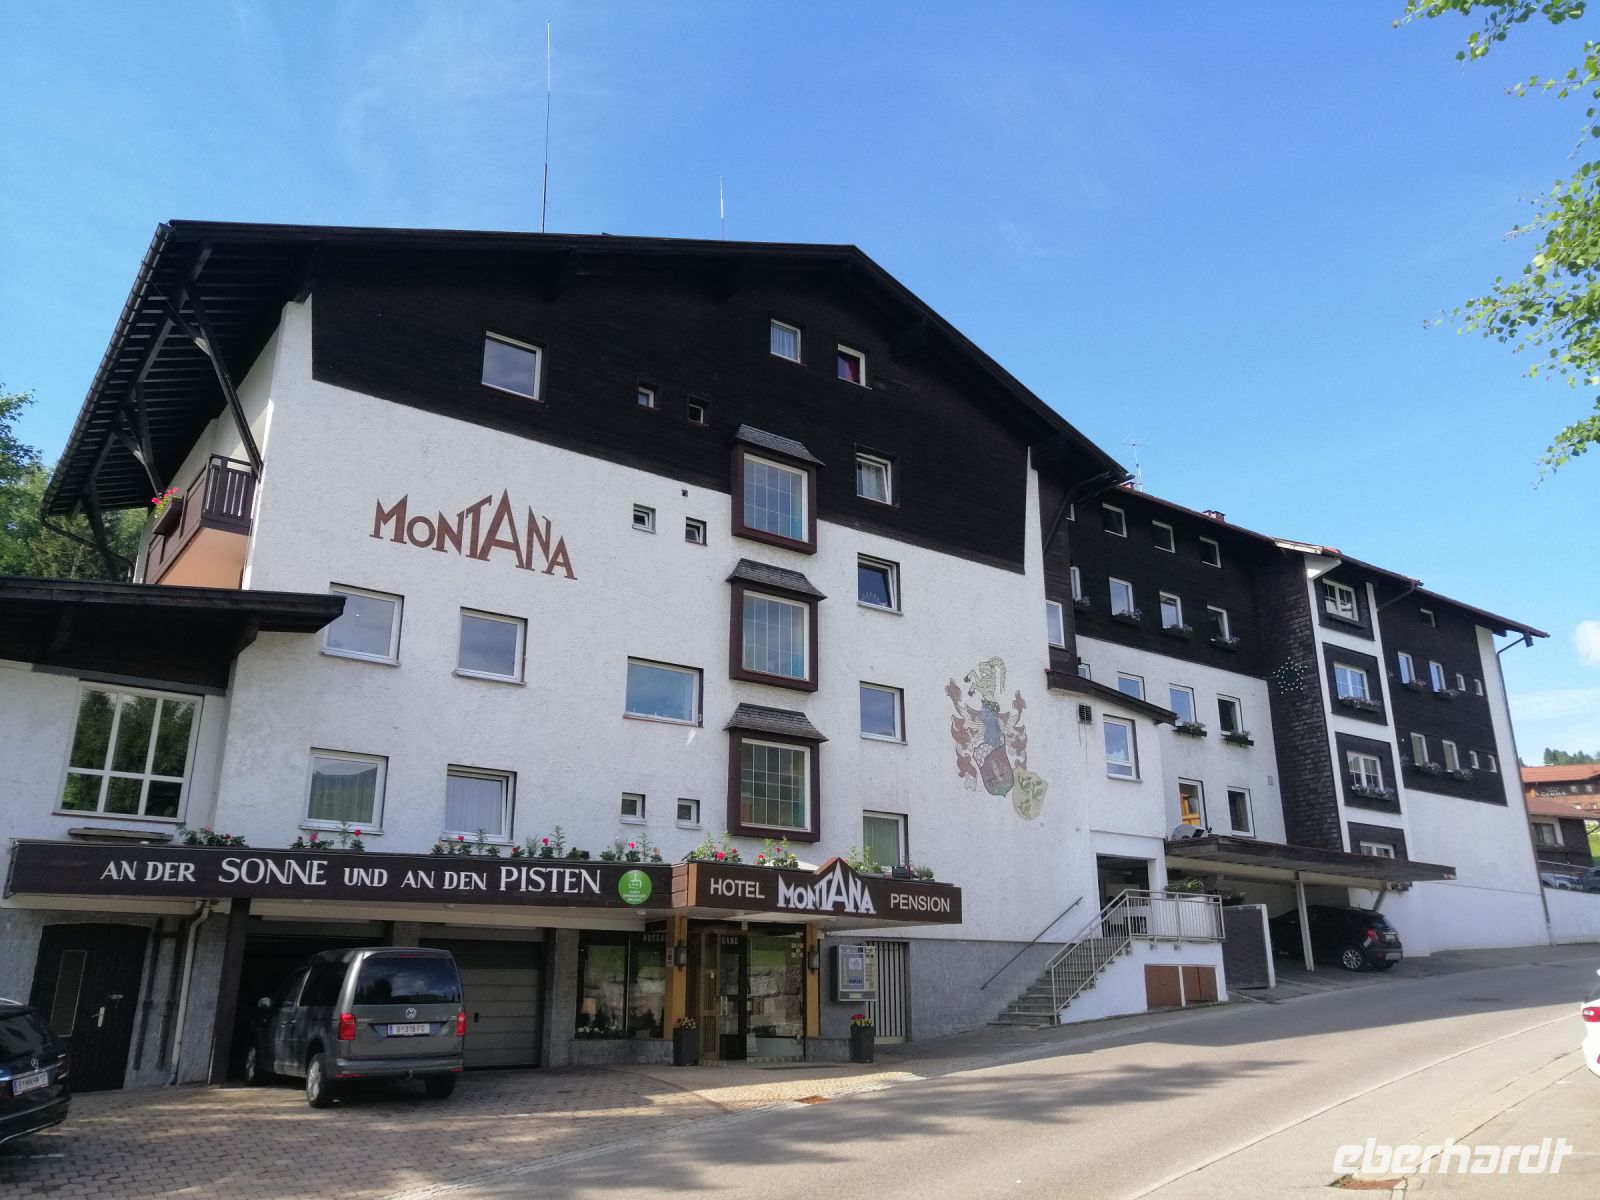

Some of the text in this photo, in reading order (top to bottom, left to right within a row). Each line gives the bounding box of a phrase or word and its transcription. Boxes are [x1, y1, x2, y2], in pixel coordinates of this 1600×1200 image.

[369, 487, 578, 581] MONTANA
[100, 857, 601, 894] AN DER SONNE UND AN DEN PISTEN
[710, 877, 766, 898] HOTEL
[777, 860, 877, 914] MONTANA
[890, 893, 950, 913] PENSION
[642, 934, 665, 943] AUSGA
